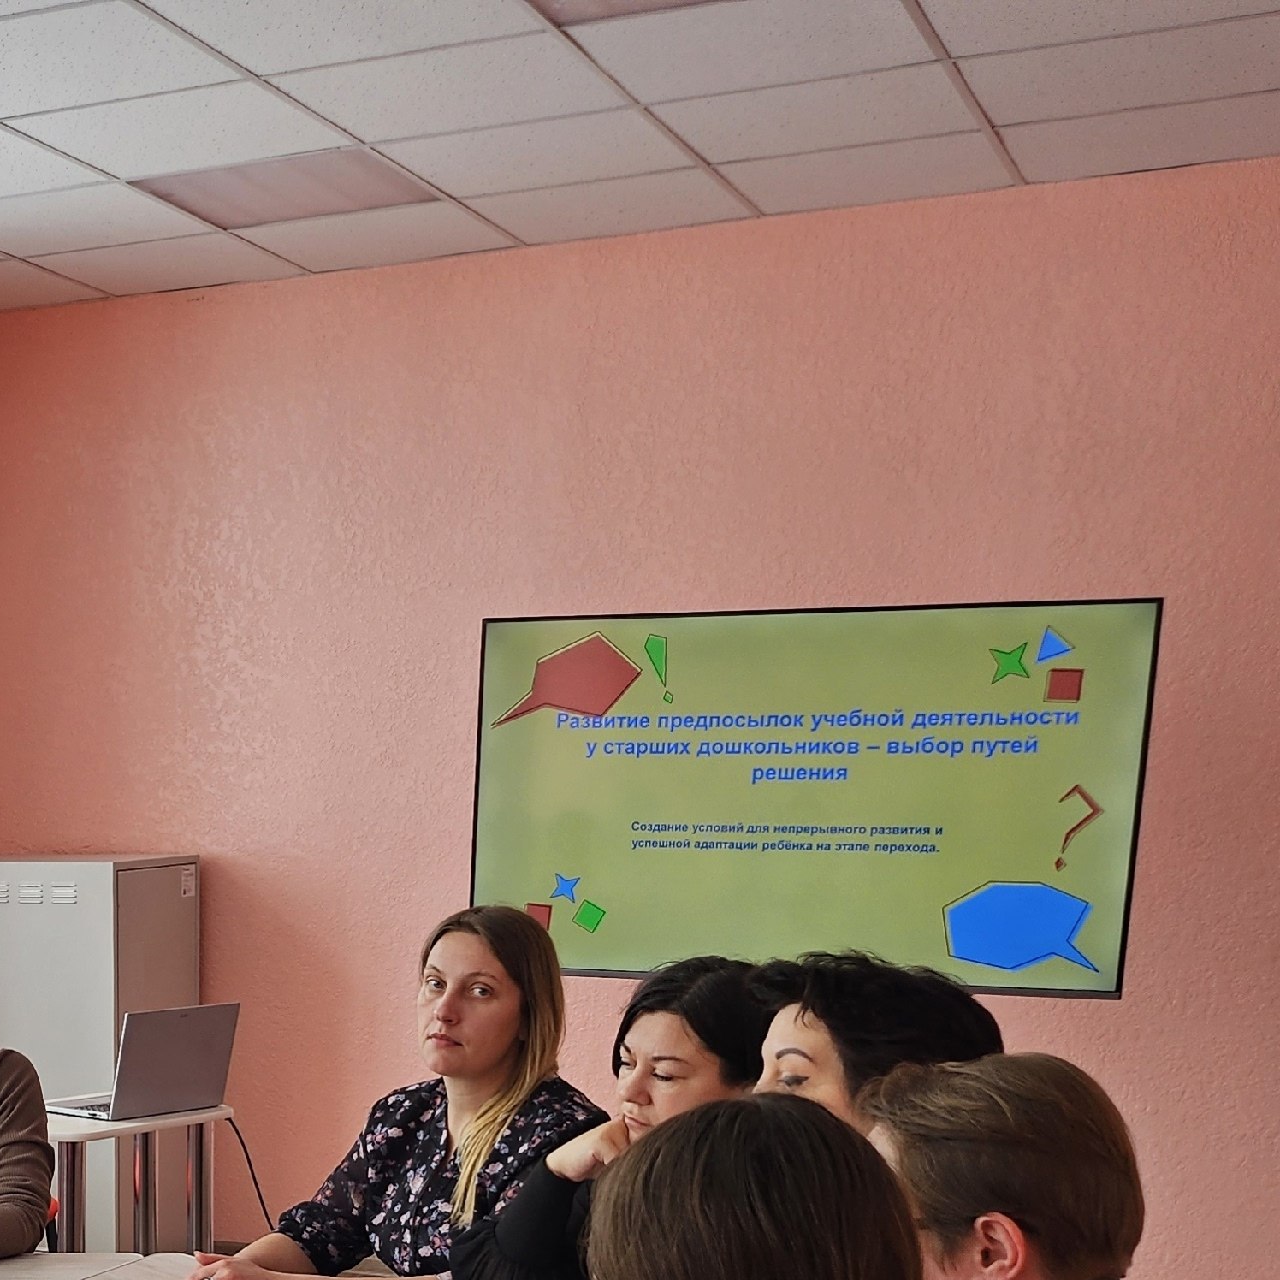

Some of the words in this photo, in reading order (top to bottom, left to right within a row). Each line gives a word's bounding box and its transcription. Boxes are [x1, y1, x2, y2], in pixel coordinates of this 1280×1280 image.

[557, 712, 650, 729] Развитие
[657, 713, 804, 732] предпосылок
[810, 709, 905, 732] учебной
[911, 711, 1080, 729] деятельности
[586, 741, 597, 758] у
[603, 740, 691, 758] старших
[696, 739, 860, 758] дошкольников
[886, 736, 964, 758] выбор
[971, 735, 1039, 758] путей
[752, 766, 848, 784] решения
[631, 821, 689, 833] Создание
[692, 822, 744, 834] условий
[746, 825, 769, 834] для
[773, 825, 867, 836] непрерывного
[870, 826, 931, 837] развития
[935, 826, 943, 835] и
[631, 838, 691, 850] успешной
[694, 840, 758, 851] адаптации
[762, 839, 813, 852] ребёнка
[816, 843, 831, 851] на
[835, 843, 870, 851] этапе
[874, 843, 940, 854] перехода.
